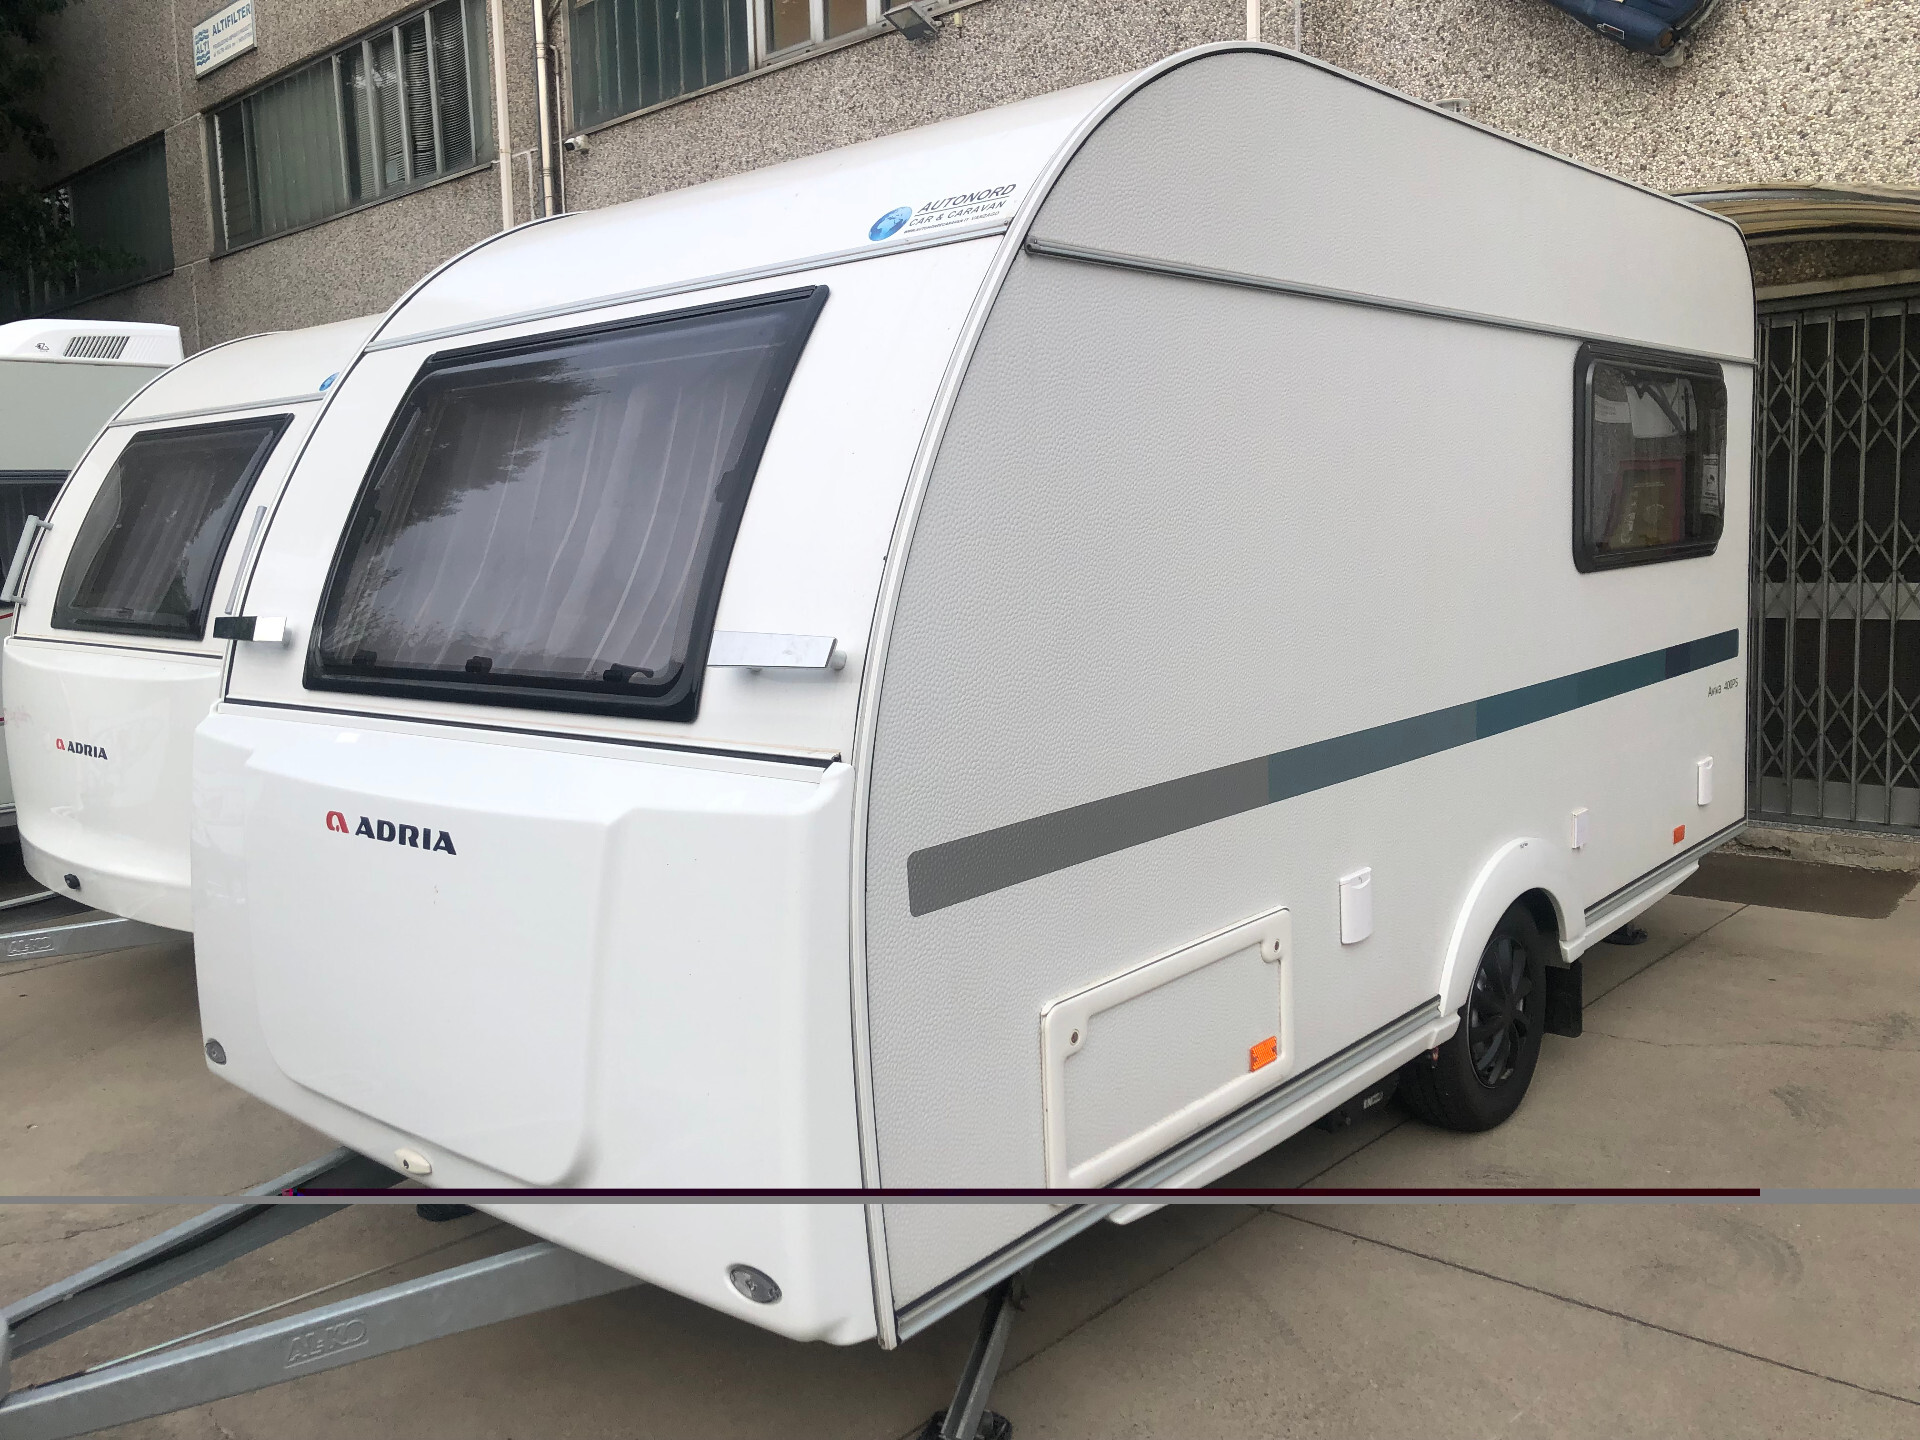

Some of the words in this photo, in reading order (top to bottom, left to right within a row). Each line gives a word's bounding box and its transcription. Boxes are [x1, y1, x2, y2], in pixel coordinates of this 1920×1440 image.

[212, 3, 251, 36] ALTIFILTER
[196, 40, 210, 55] ALTI
[909, 215, 935, 226] CAR
[936, 213, 944, 221] &
[947, 200, 1007, 219] CARAVAN
[917, 183, 1017, 213] AUTONORD
[67, 740, 108, 760] ADRIA
[355, 815, 457, 856] ADRIA
[288, 1319, 368, 1362] AL-KO
